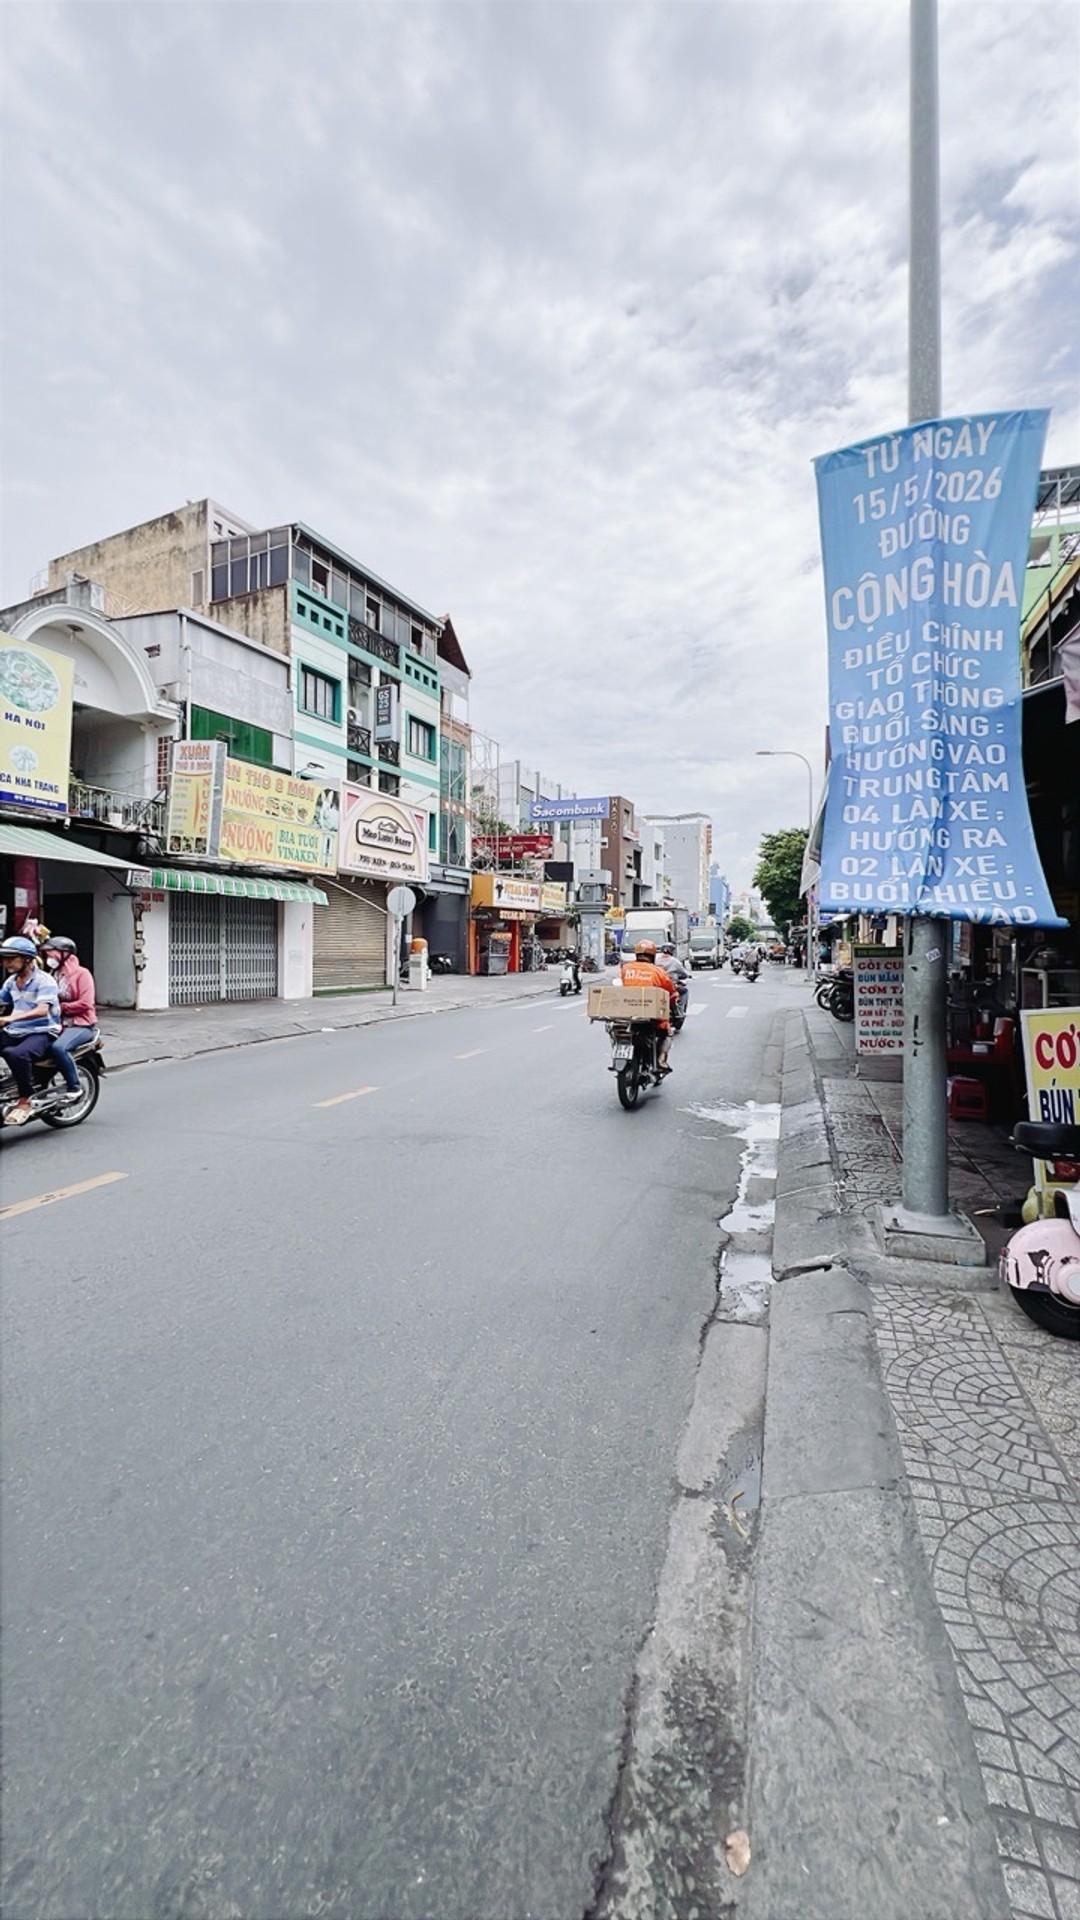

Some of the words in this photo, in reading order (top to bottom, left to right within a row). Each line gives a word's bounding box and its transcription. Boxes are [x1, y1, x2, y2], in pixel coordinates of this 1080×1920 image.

[861, 432, 902, 478] TỪ
[913, 416, 997, 463] NGÀY
[853, 467, 1002, 524] 15/5/2026
[878, 503, 970, 558] ĐƯỜNG
[832, 556, 935, 632] CỘNG
[944, 550, 1017, 608] HÒA
[922, 621, 1003, 651] CHỈNH
[866, 654, 905, 690] TỔ
[911, 652, 981, 680] CHỨC
[836, 691, 904, 720] GIAO
[842, 711, 910, 744] BUỔI
[921, 709, 990, 737] SÁNG
[846, 739, 944, 772] HƯỚNG
[947, 739, 1006, 765] VÀO
[275, 778, 284, 793] 8
[843, 768, 941, 798] TRUNG
[945, 769, 1009, 793] TÂM
[532, 802, 605, 818] Sacombank
[843, 805, 881, 824] 04
[892, 794, 943, 824] LÀN
[949, 800, 988, 821] XE
[279, 830, 295, 844] BIA
[850, 825, 950, 851] HƯỚNG
[963, 828, 1007, 848] RA
[841, 857, 878, 876] 02
[891, 853, 943, 878] LÀN
[953, 855, 998, 877] XE
[830, 878, 909, 902] BUỔI
[966, 903, 1037, 925] VÀO
[859, 985, 887, 994] CƠM
[860, 1038, 895, 1048] NƯỚC
[1035, 1023, 1080, 1069] CƠ
[1039, 1078, 1075, 1124] BÚN
